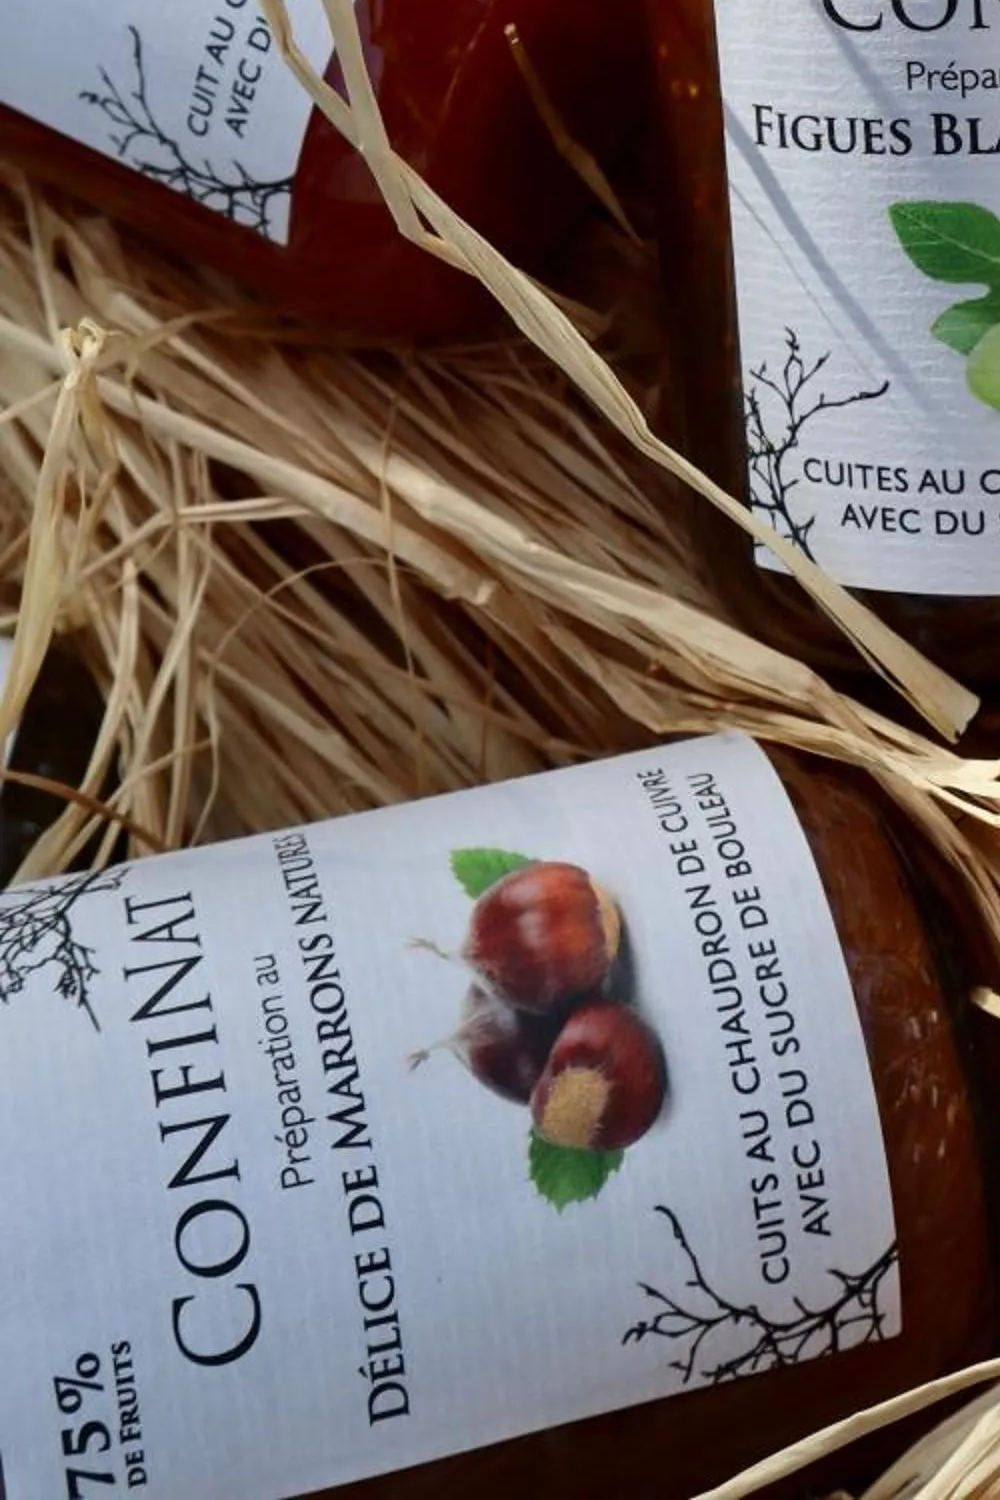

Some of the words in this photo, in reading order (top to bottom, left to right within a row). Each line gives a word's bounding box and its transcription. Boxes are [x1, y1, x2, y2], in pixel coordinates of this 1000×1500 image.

[187, 63, 220, 137] CUIT
[204, 15, 236, 67] AU
[224, 58, 262, 140] AVEC
[751, 103, 913, 156] FIGUES
[803, 456, 909, 494] CUITES
[917, 469, 966, 495] AU
[839, 503, 921, 534] AVEC
[935, 508, 986, 536] DU
[636, 767, 689, 834] CUIVRE
[685, 772, 753, 879] BOULEAU
[669, 838, 706, 877] DE
[731, 885, 769, 930] DE
[253, 953, 282, 986] au
[685, 883, 761, 1095] CHAUDRON
[747, 937, 801, 1057] SUCRE
[298, 932, 374, 1151] MARRONS
[122, 891, 262, 1367] CONFINAT
[257, 993, 316, 1190] Préparation
[739, 1110, 776, 1163] AU
[777, 1069, 815, 1129] DU
[341, 1164, 386, 1237] DE
[751, 1172, 790, 1285] CUITS
[791, 1139, 832, 1237] AVEC
[353, 1247, 411, 1427] DÉLICE
[53, 1351, 117, 1500] 75%
[111, 1339, 142, 1445] FRUITS
[124, 1449, 147, 1489] DE
